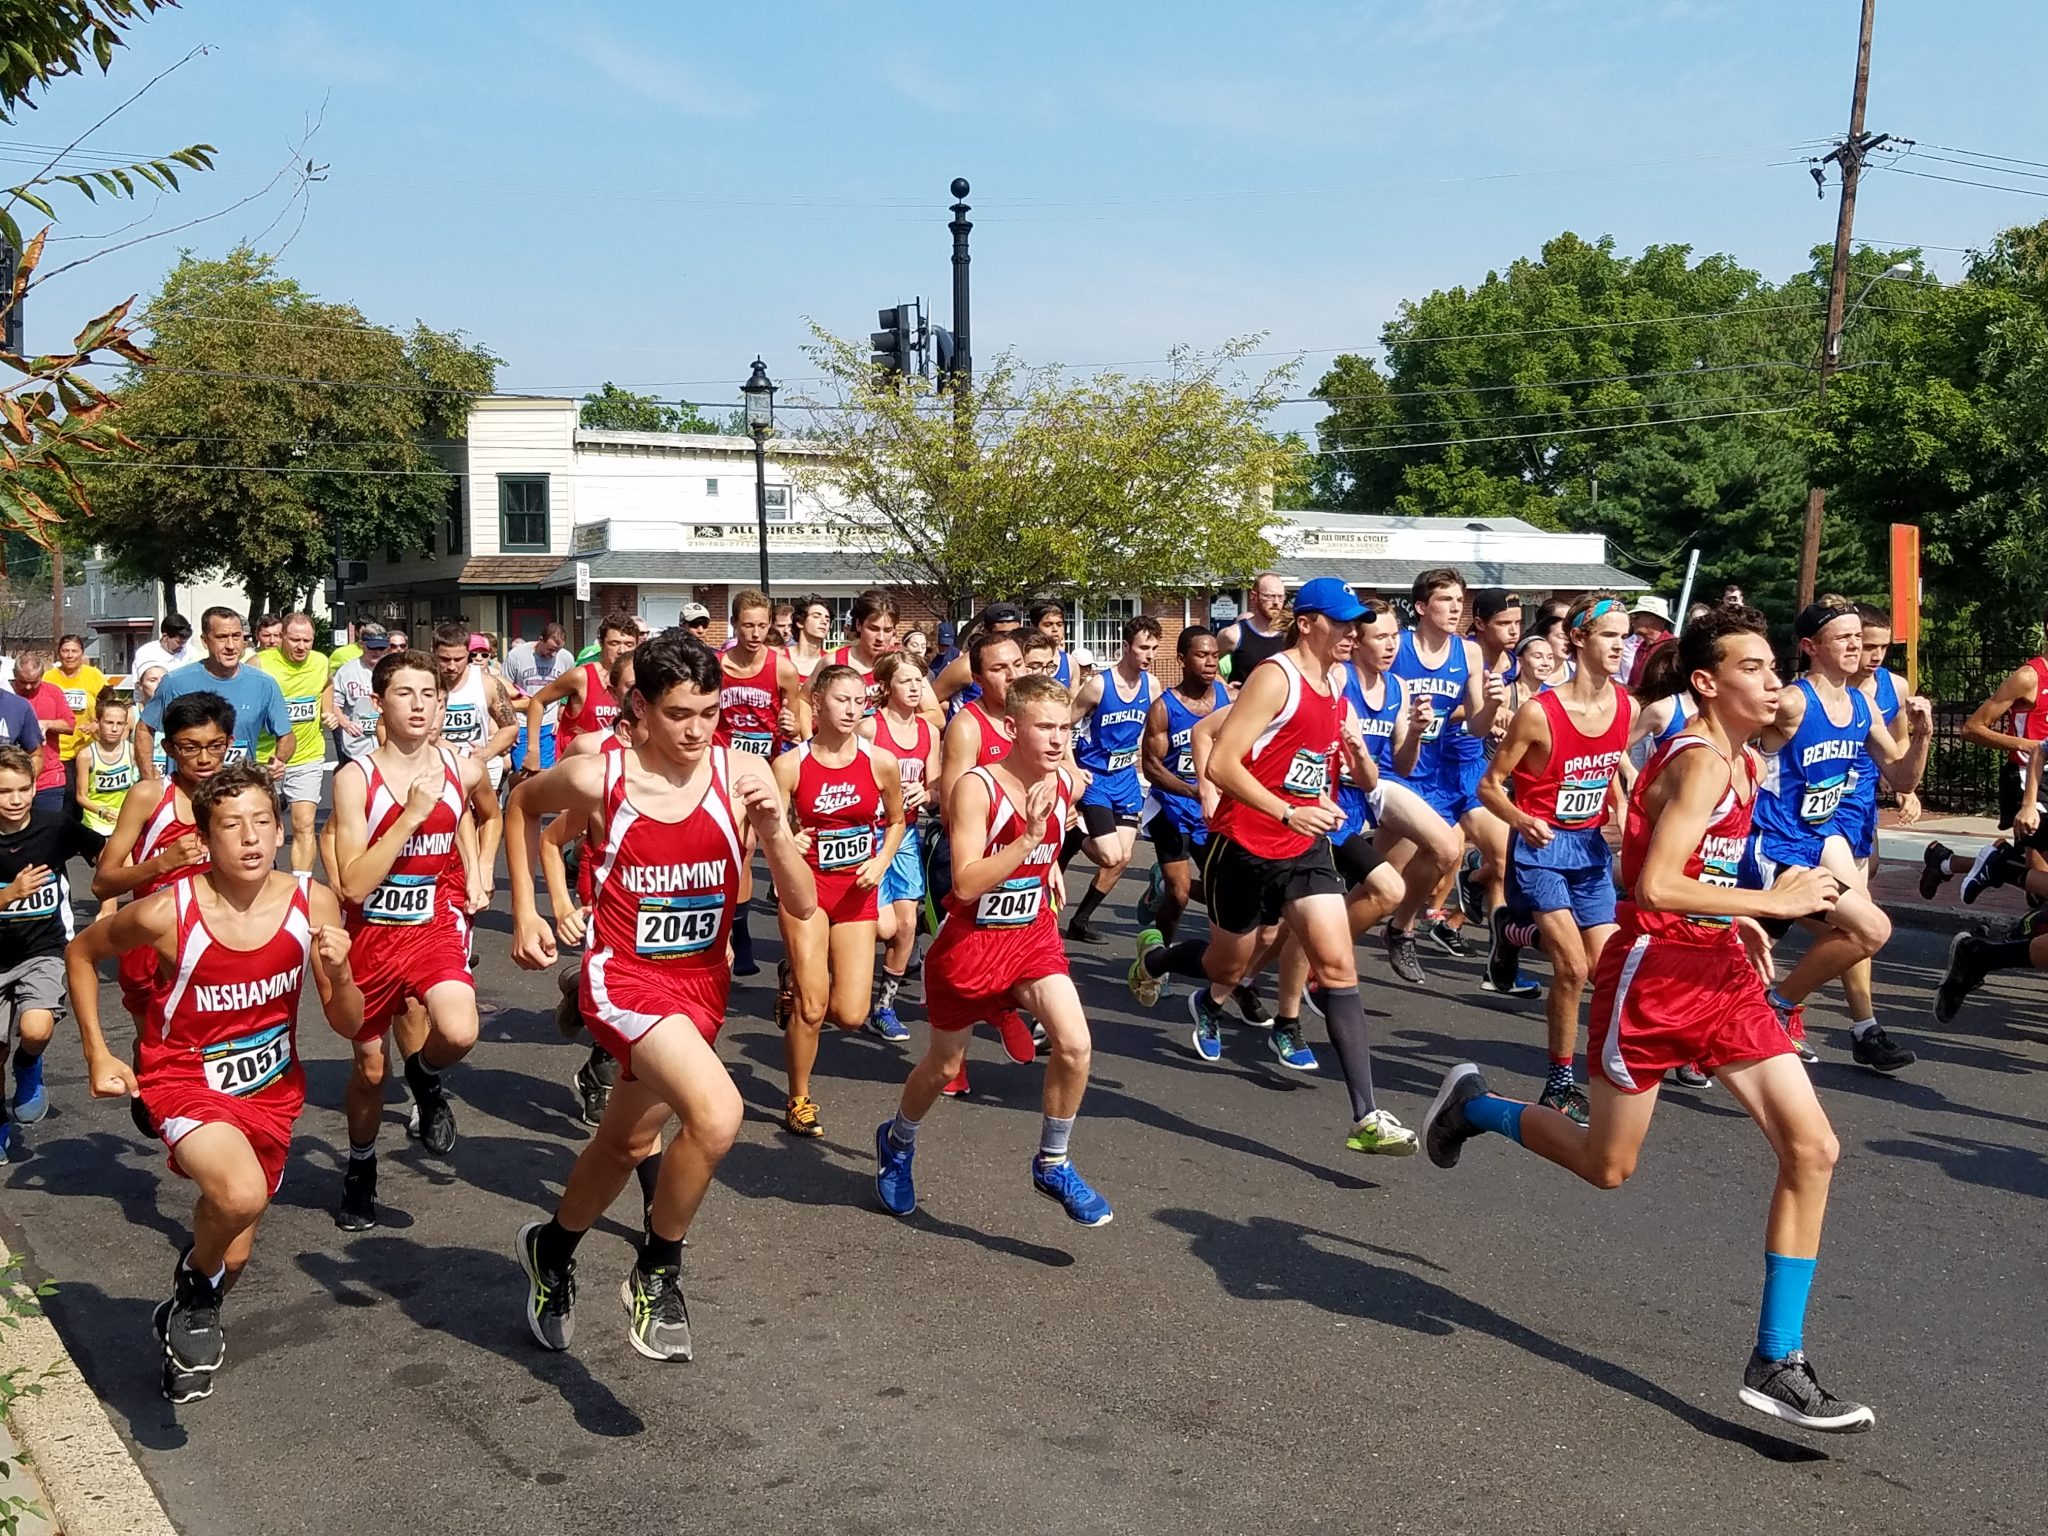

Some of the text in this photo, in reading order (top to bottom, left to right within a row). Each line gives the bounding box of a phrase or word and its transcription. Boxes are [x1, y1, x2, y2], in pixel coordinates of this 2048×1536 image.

[729, 525, 755, 535] ALL
[764, 525, 805, 535] IKES
[1363, 535, 1389, 543] CYCLES
[595, 705, 621, 717] DRA
[1564, 750, 1621, 775] DRAKES
[98, 772, 128, 788] 2214
[820, 781, 856, 796] Lady
[813, 793, 862, 815] Skins
[1562, 791, 1603, 812] 2079
[400, 831, 455, 857] HAMINY
[822, 836, 868, 861] 2056
[621, 858, 728, 894] NESHAMINY
[6, 886, 55, 913] 208
[369, 887, 429, 912] 2048
[985, 891, 1037, 917] 2047
[643, 912, 717, 943] 2043
[193, 964, 303, 1012] NESHAMINY
